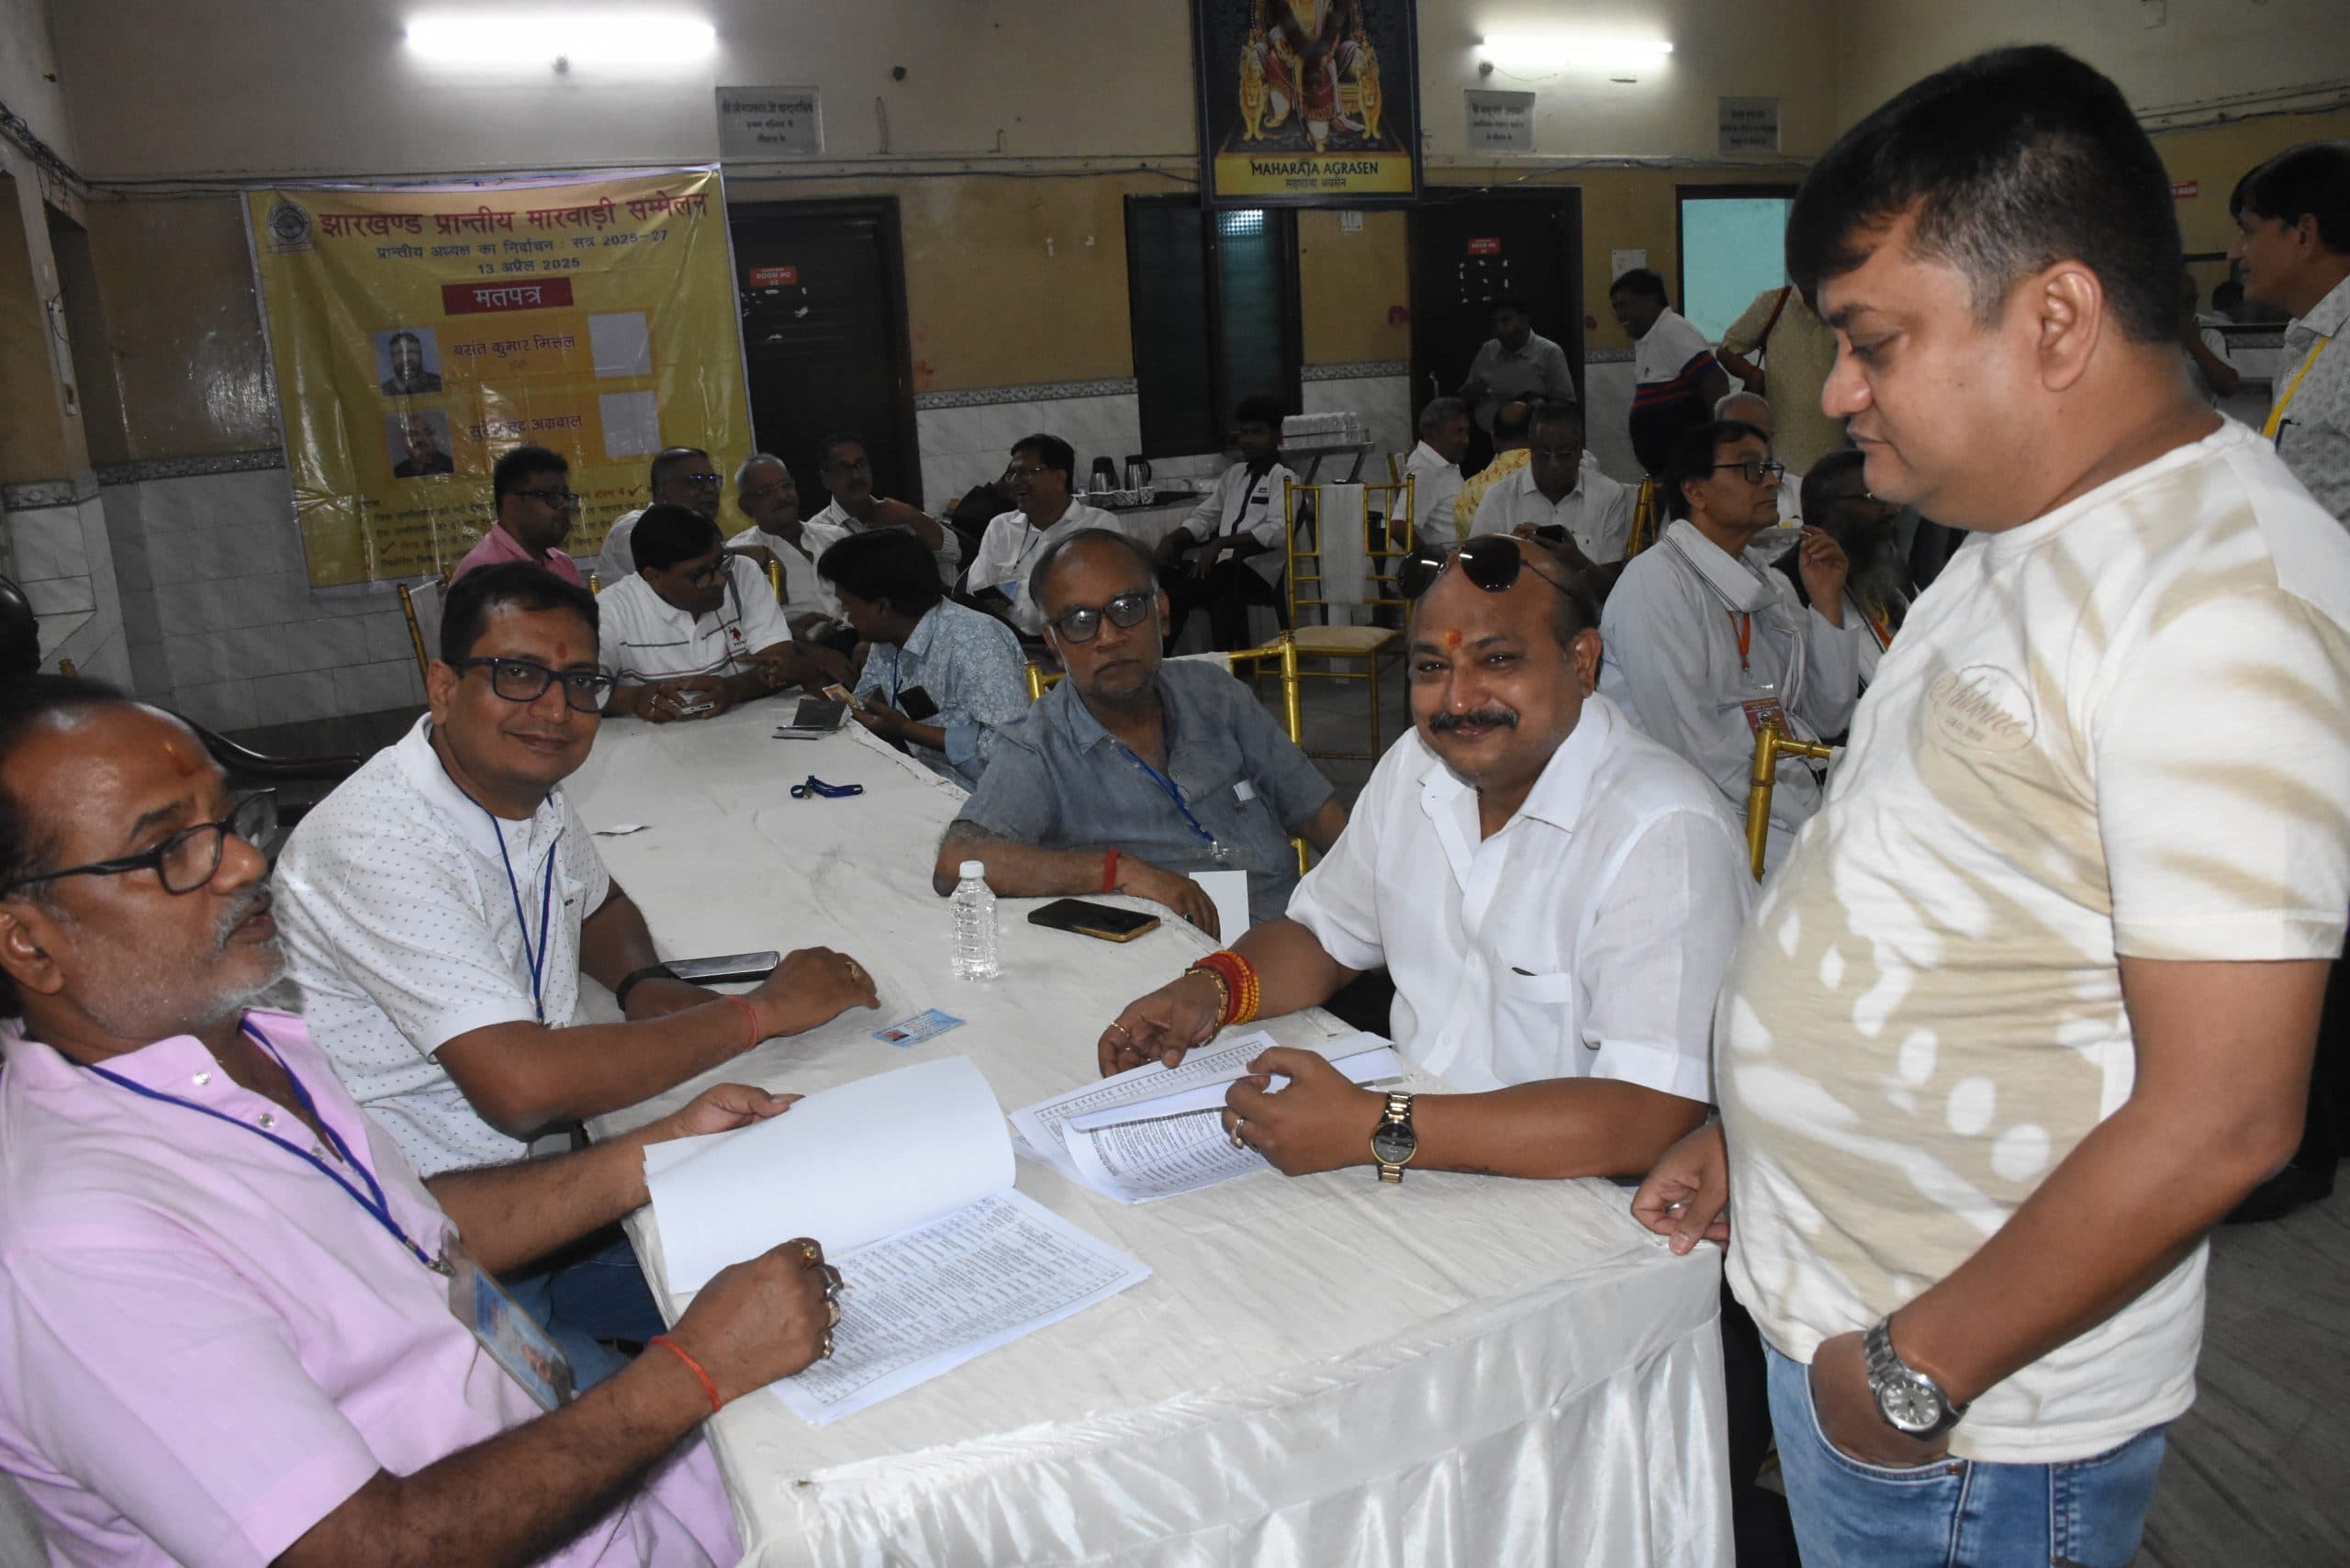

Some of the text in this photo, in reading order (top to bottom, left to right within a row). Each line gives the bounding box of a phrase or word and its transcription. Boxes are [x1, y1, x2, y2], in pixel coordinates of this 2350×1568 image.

[1250, 161, 1379, 177] MAHARAJA AGRASEN
[319, 213, 422, 237] झारखण्ड
[433, 205, 516, 234] प्रान्तीय
[526, 196, 616, 230] मारवाड़ी
[626, 190, 709, 222] सम्मेलन
[476, 243, 497, 255] का
[477, 263, 494, 274] 13
[543, 257, 581, 270] 2025
[472, 286, 542, 308] मतपत्र
[491, 339, 530, 358] कुमार
